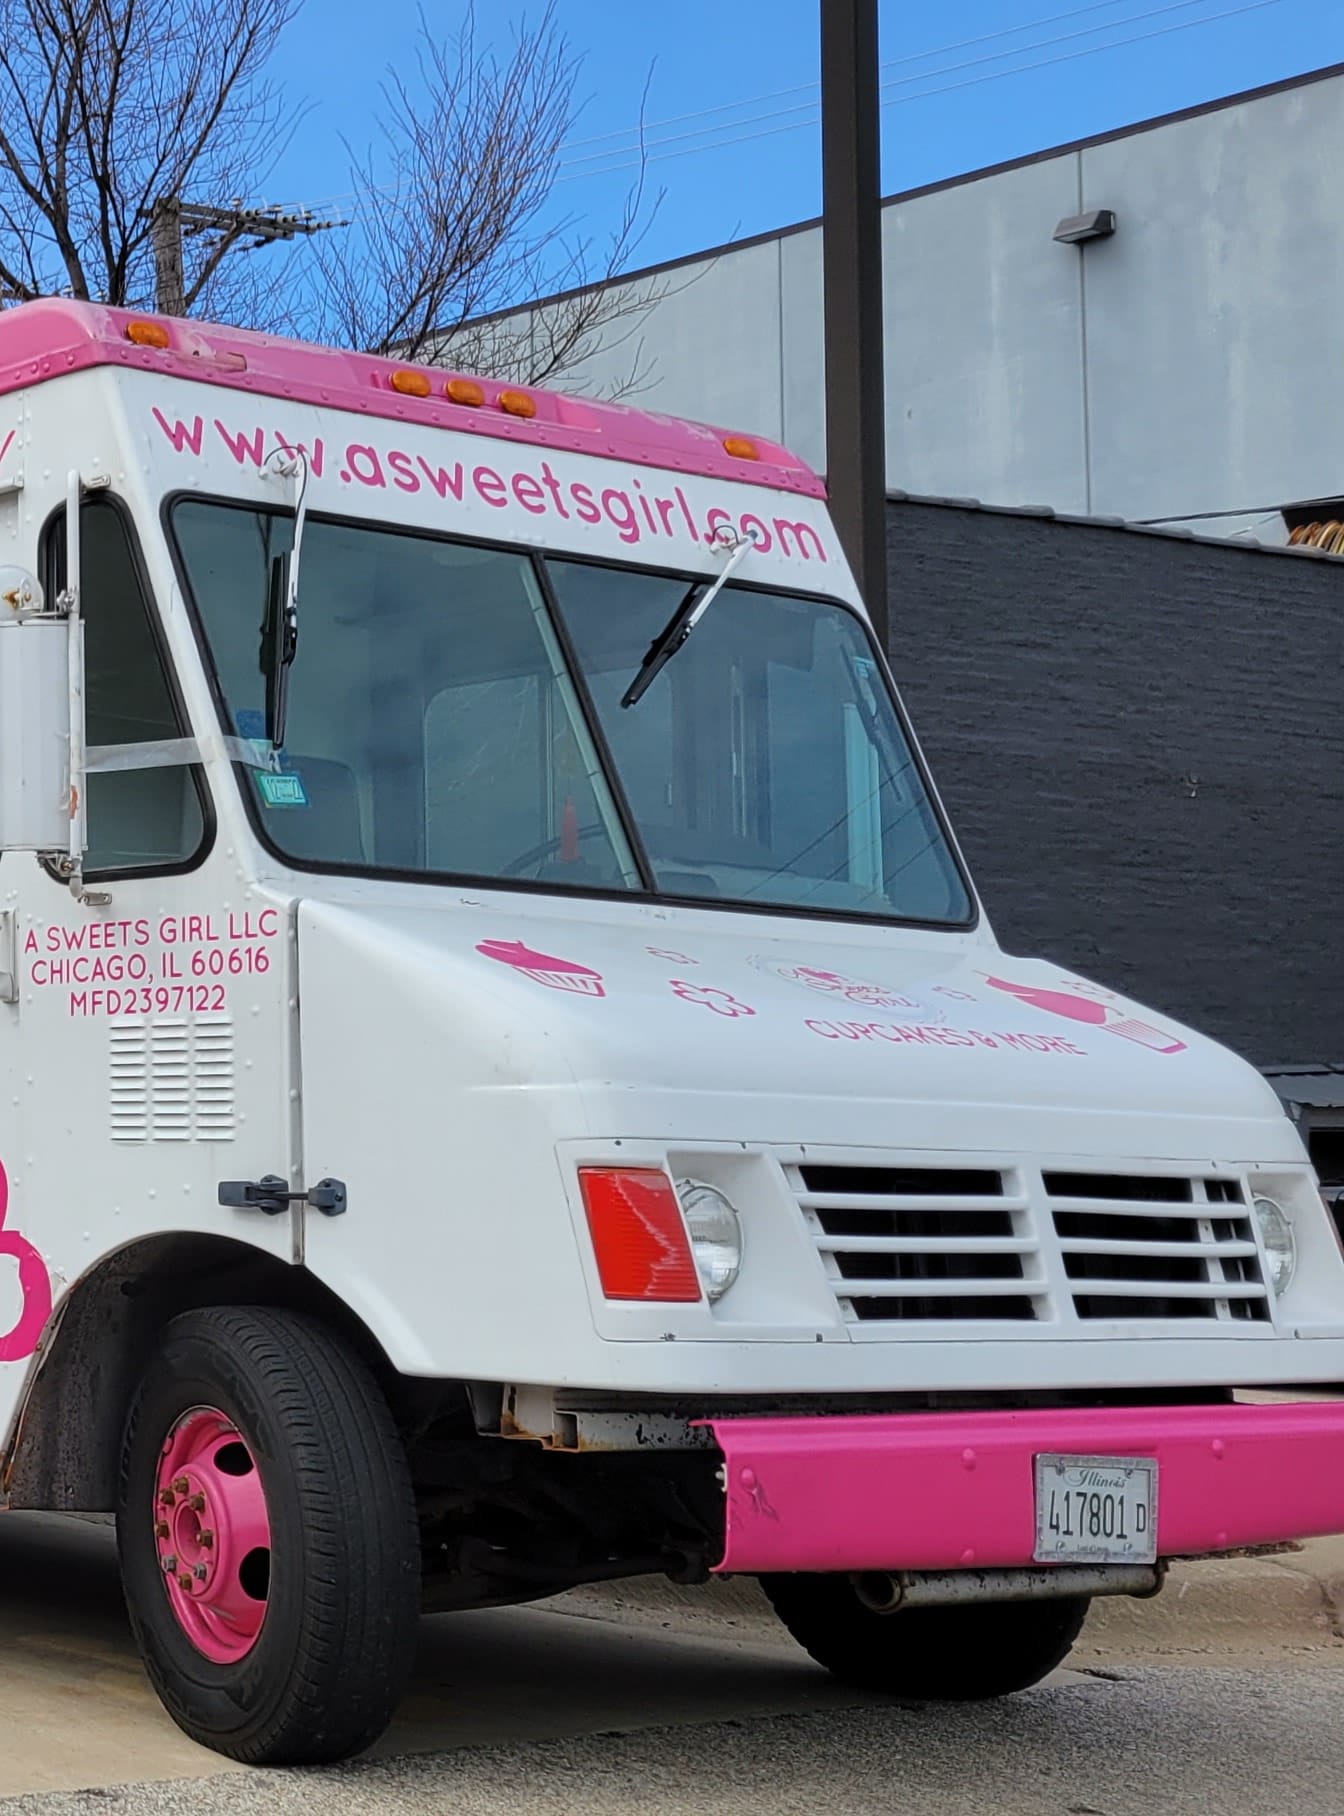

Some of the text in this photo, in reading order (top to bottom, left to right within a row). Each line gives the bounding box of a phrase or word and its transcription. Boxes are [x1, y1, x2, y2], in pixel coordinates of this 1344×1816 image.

[151, 406, 828, 563] www.asweetsgirl.com
[25, 909, 278, 953] A SWEETS GIRL LLC
[31, 946, 270, 985] CHICAGO, IL 60616
[70, 984, 226, 1017] MFD2397122
[804, 1019, 1089, 1056] CUPCAKES & MORE
[1063, 1469, 1127, 1488] Illinois
[1049, 1490, 1147, 1539] 417801 D
